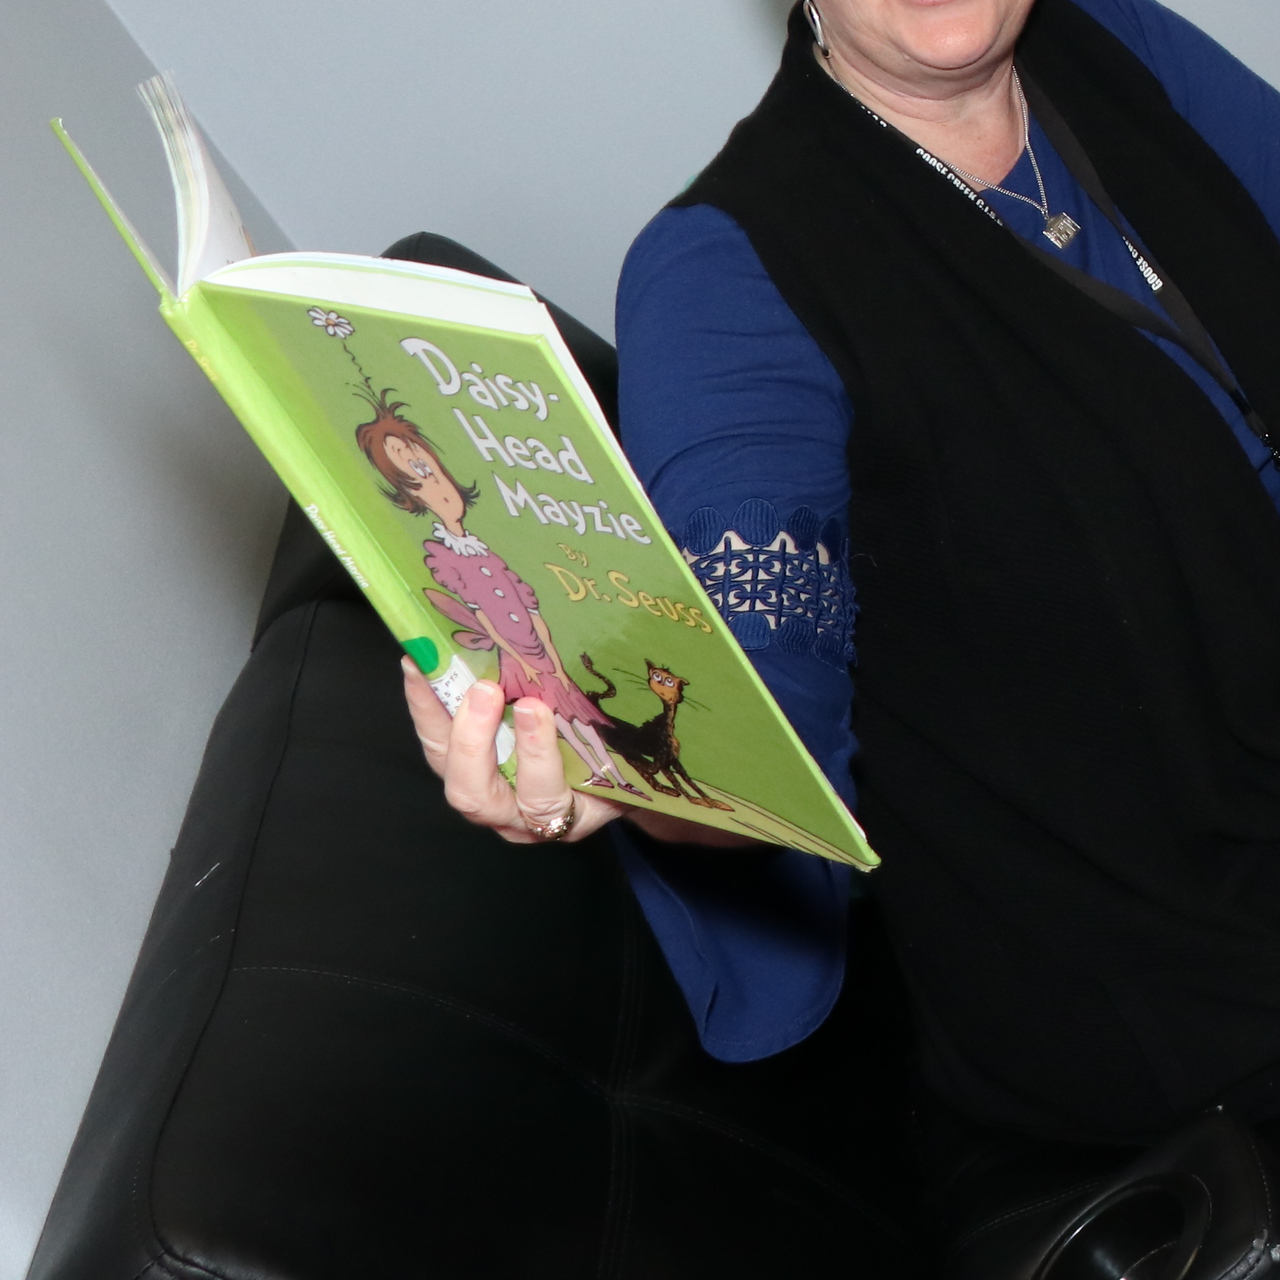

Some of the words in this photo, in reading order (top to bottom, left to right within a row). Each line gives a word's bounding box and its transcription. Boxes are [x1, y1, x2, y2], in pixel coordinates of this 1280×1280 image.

[1136, 255, 1164, 291] GOOSE
[399, 336, 560, 422] Daisy-
[452, 406, 595, 485] Head
[491, 470, 653, 546] Mayzie
[322, 530, 347, 558] Head
[342, 554, 370, 589] Mayzie
[556, 542, 589, 568] By
[543, 561, 612, 602] Dr.
[606, 569, 714, 634] Seuss
